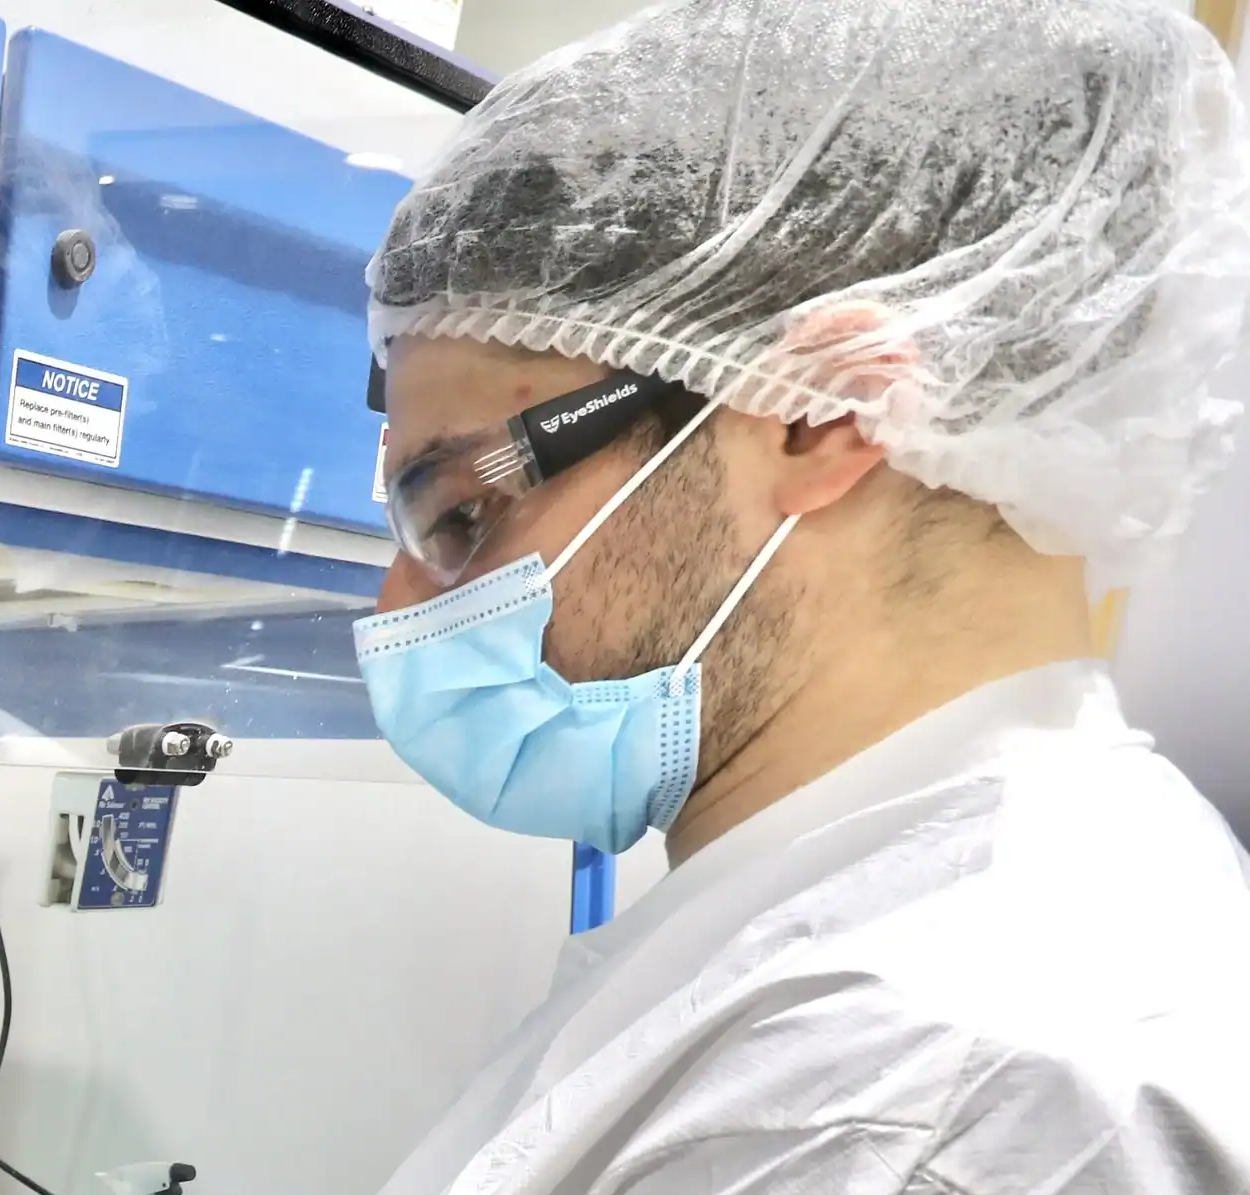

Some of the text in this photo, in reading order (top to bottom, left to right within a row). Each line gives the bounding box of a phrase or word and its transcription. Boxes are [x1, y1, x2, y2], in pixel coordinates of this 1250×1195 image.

[41, 370, 101, 401] NOTICE
[19, 398, 90, 425] Replace pre-filter(s)
[560, 383, 639, 426] EyeShields
[17, 415, 110, 447] and main filter(s) regularly
